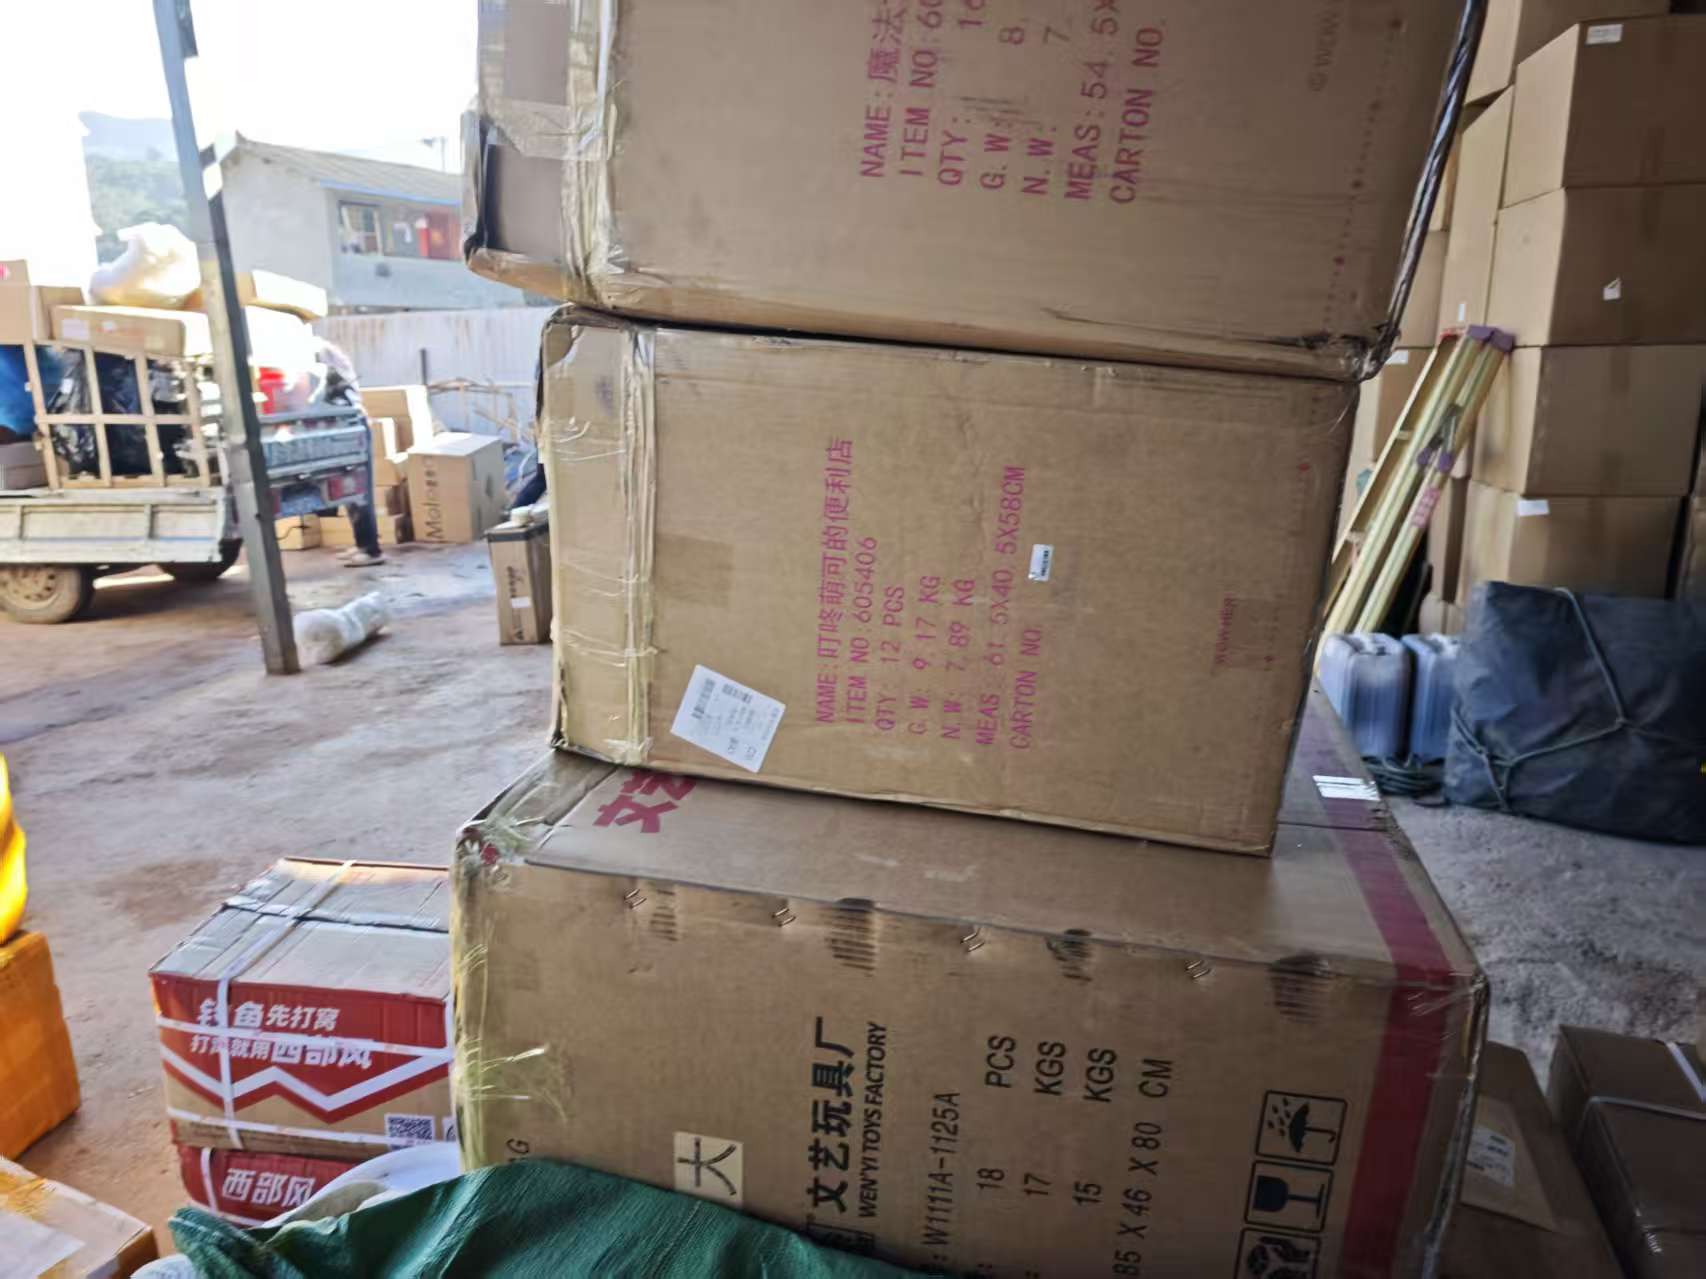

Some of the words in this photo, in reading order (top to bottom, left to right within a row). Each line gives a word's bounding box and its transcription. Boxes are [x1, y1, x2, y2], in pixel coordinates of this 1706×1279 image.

[897, 108, 929, 176] ITEM
[1109, 89, 1151, 204] CARTON
[883, 586, 904, 626] PCS
[918, 576, 940, 603] KG
[953, 579, 975, 606] KG
[881, 641, 900, 663] 12
[846, 676, 868, 724] ITEM
[1009, 672, 1037, 749] CARTON
[864, 1022, 887, 1106] FACTORY
[985, 1036, 1016, 1088] PCS
[1034, 1042, 1065, 1096] KGS
[1083, 1049, 1116, 1102] KGS
[1139, 1059, 1172, 1098] CM
[807, 1017, 854, 1213] 文艺玩具厂
[861, 1109, 882, 1152] TOYS
[1132, 1122, 1161, 1149] 80
[222, 1168, 315, 1207] 西部风
[677, 1138, 736, 1196] 大
[977, 1168, 1005, 1190] 18
[1024, 1173, 1051, 1196] 17
[1073, 1182, 1101, 1205] 15
[1122, 1189, 1151, 1216] 46
